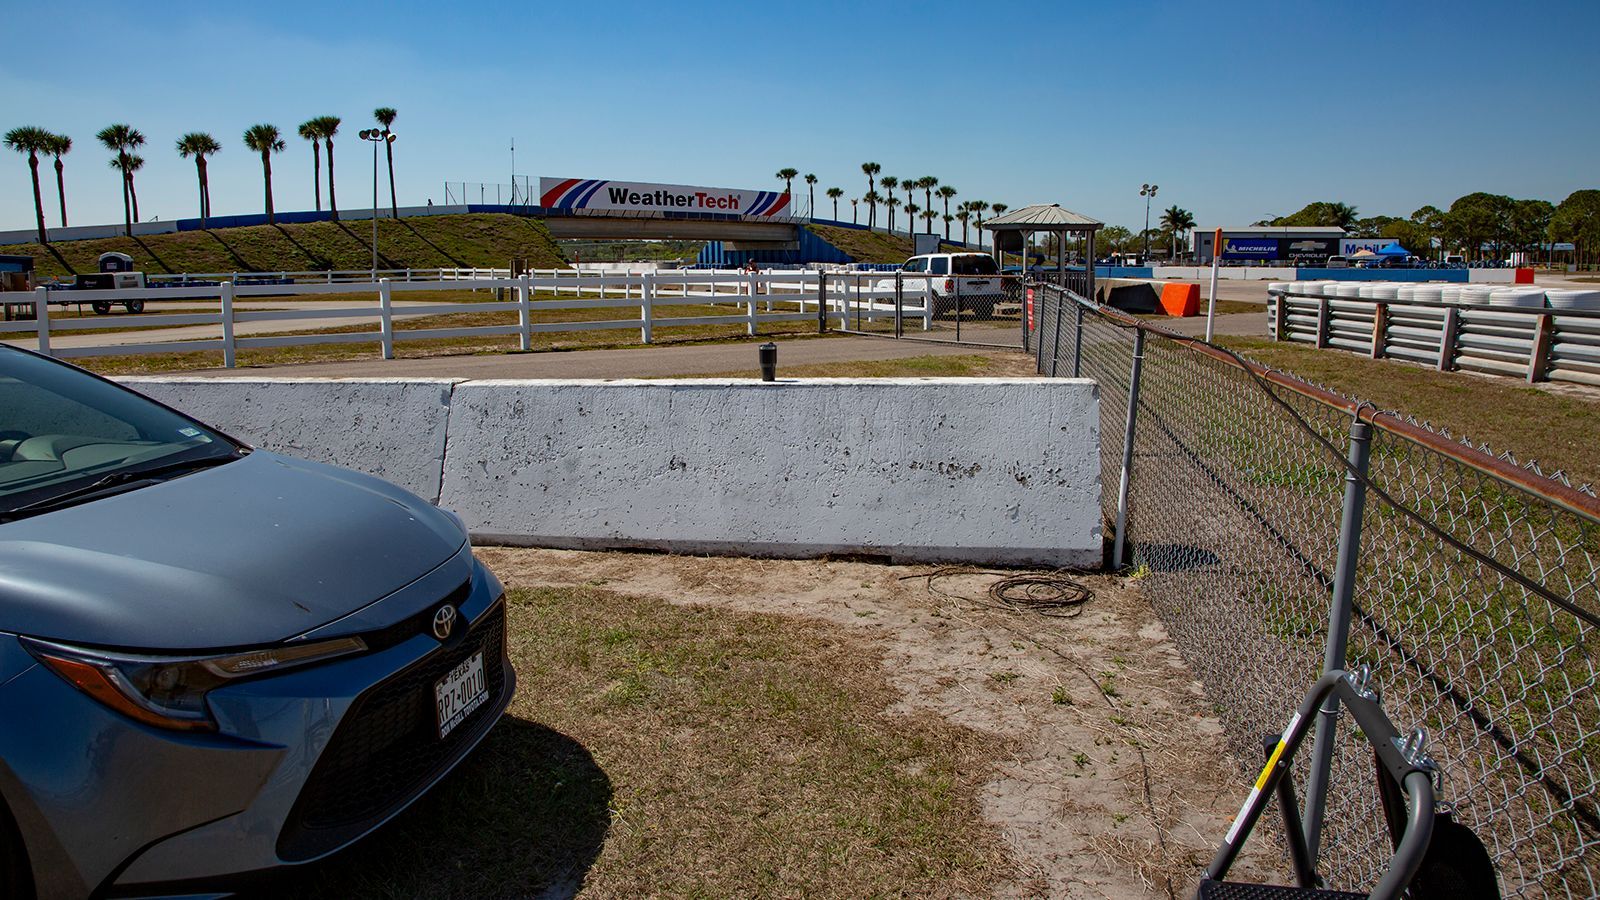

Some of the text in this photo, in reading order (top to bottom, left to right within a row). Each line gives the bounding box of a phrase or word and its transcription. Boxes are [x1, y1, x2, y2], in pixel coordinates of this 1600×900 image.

[608, 187, 739, 210] WeatherTech
[1345, 244, 1379, 254] Mobil
[450, 664, 470, 683] TEXAS
